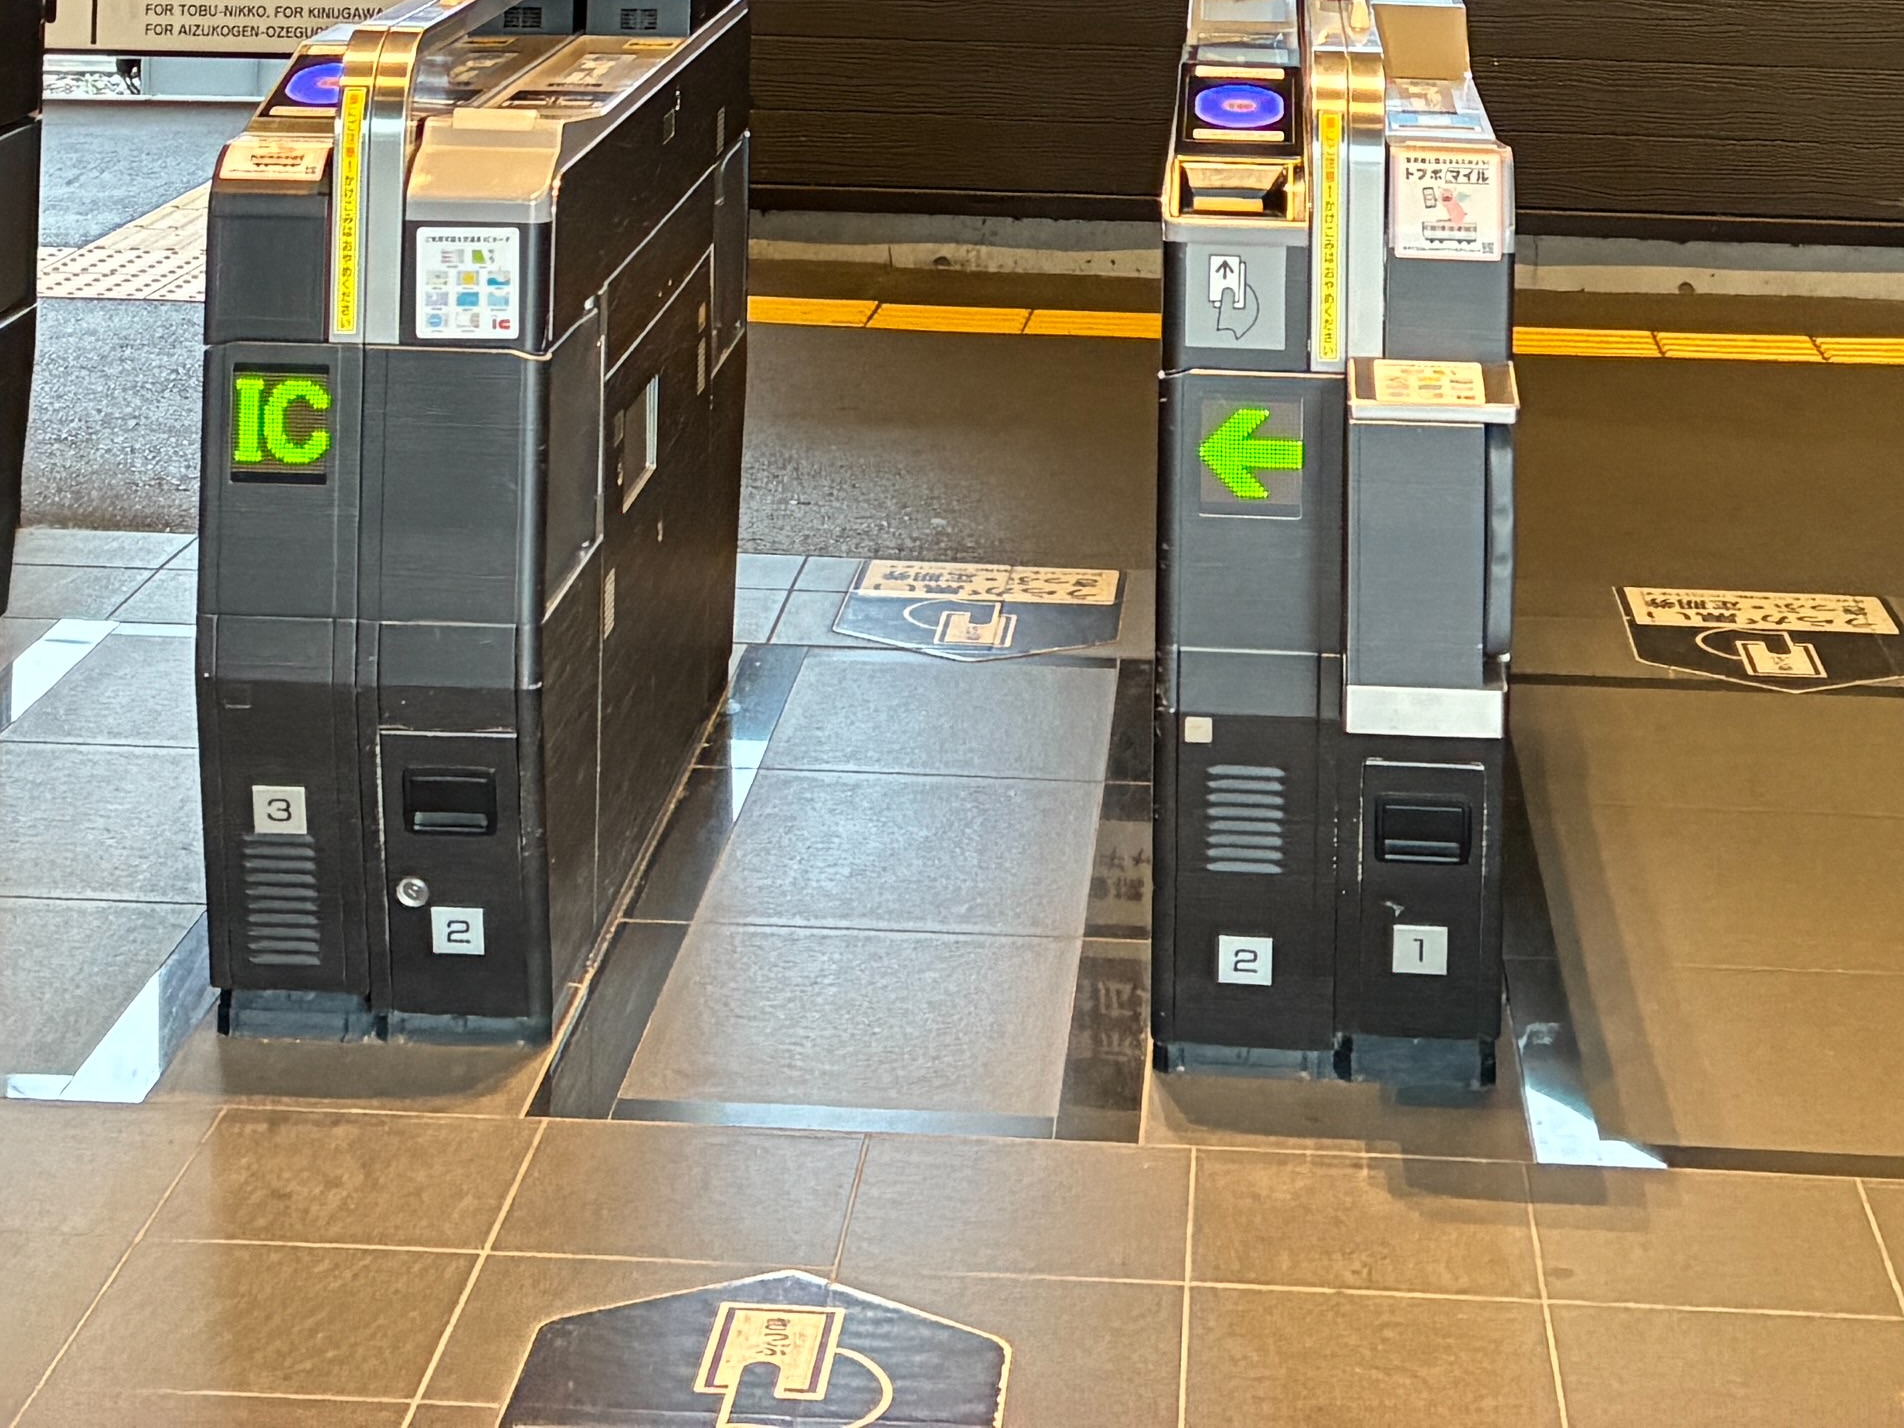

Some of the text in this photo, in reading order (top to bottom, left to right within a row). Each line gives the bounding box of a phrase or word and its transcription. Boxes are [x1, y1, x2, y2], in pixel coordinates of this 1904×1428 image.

[145, 2, 174, 17] FOR
[274, 5, 304, 19] FOR
[145, 23, 173, 37] FOR
[234, 376, 332, 465] IC
[267, 798, 292, 823] 3
[446, 920, 471, 944] 2
[1233, 949, 1258, 974] 2
[1412, 938, 1425, 963] 1
